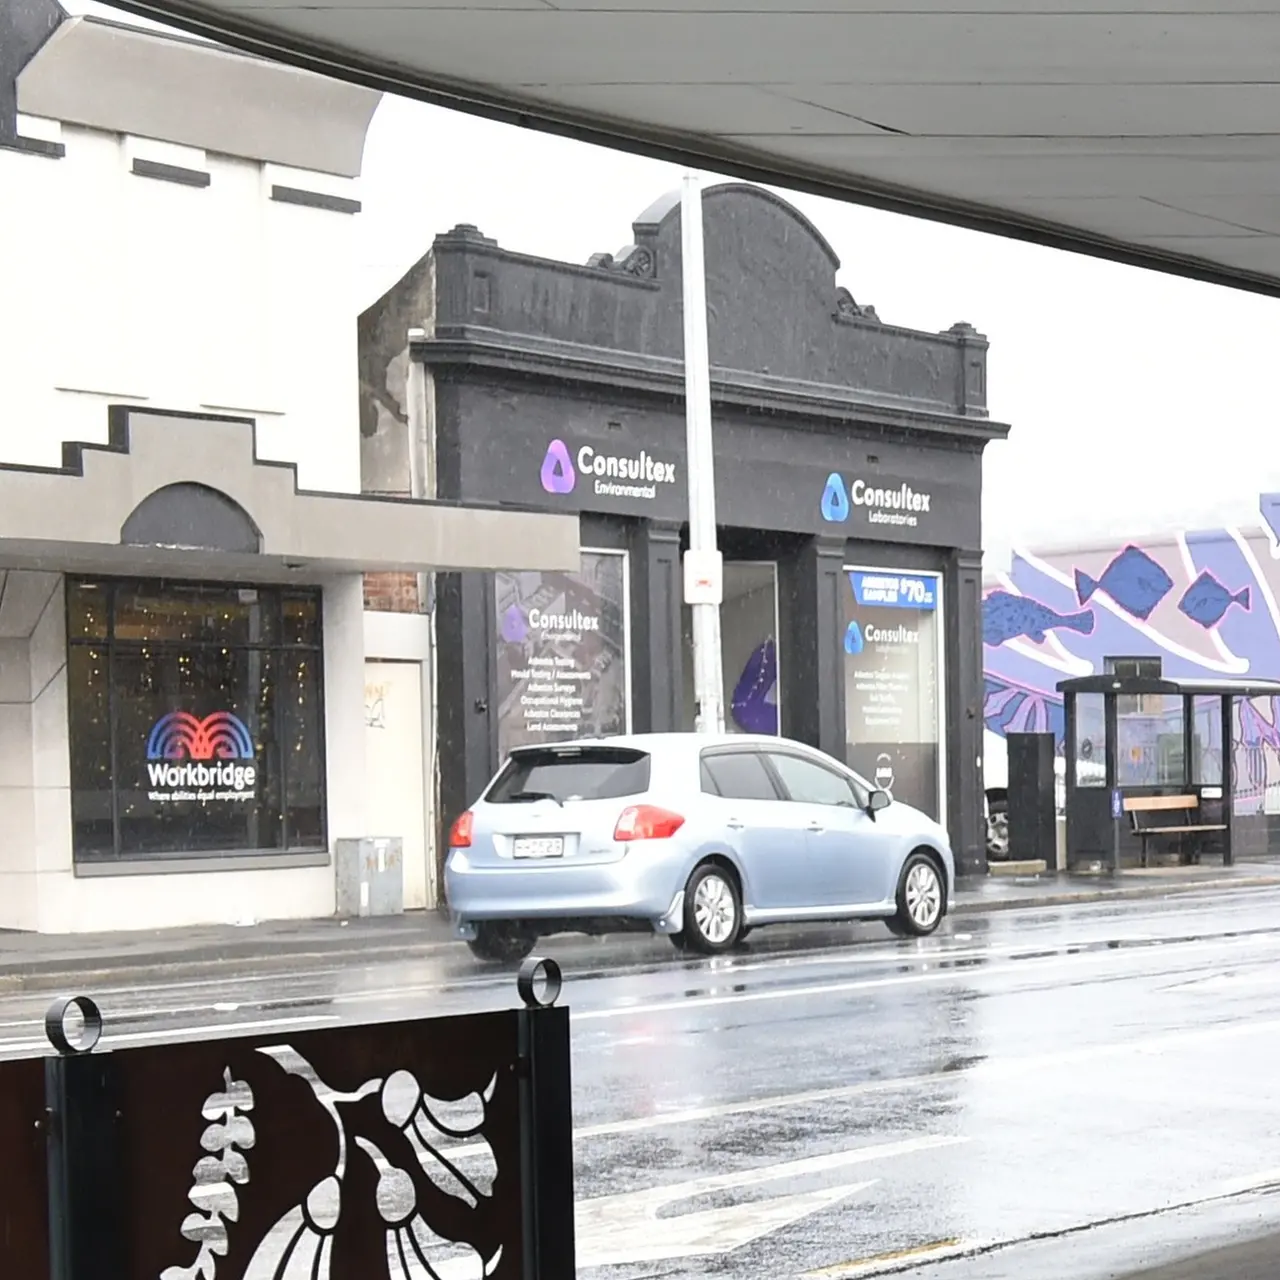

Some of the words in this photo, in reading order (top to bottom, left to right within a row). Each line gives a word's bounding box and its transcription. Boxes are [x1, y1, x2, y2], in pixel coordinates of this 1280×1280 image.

[577, 445, 675, 483] Consultex
[594, 479, 656, 499] Environmental
[851, 479, 930, 512] Consultex
[868, 509, 918, 527] Laboratories
[528, 608, 599, 630] Consultex
[864, 624, 919, 643] Consultex
[147, 761, 256, 790] Workbridge
